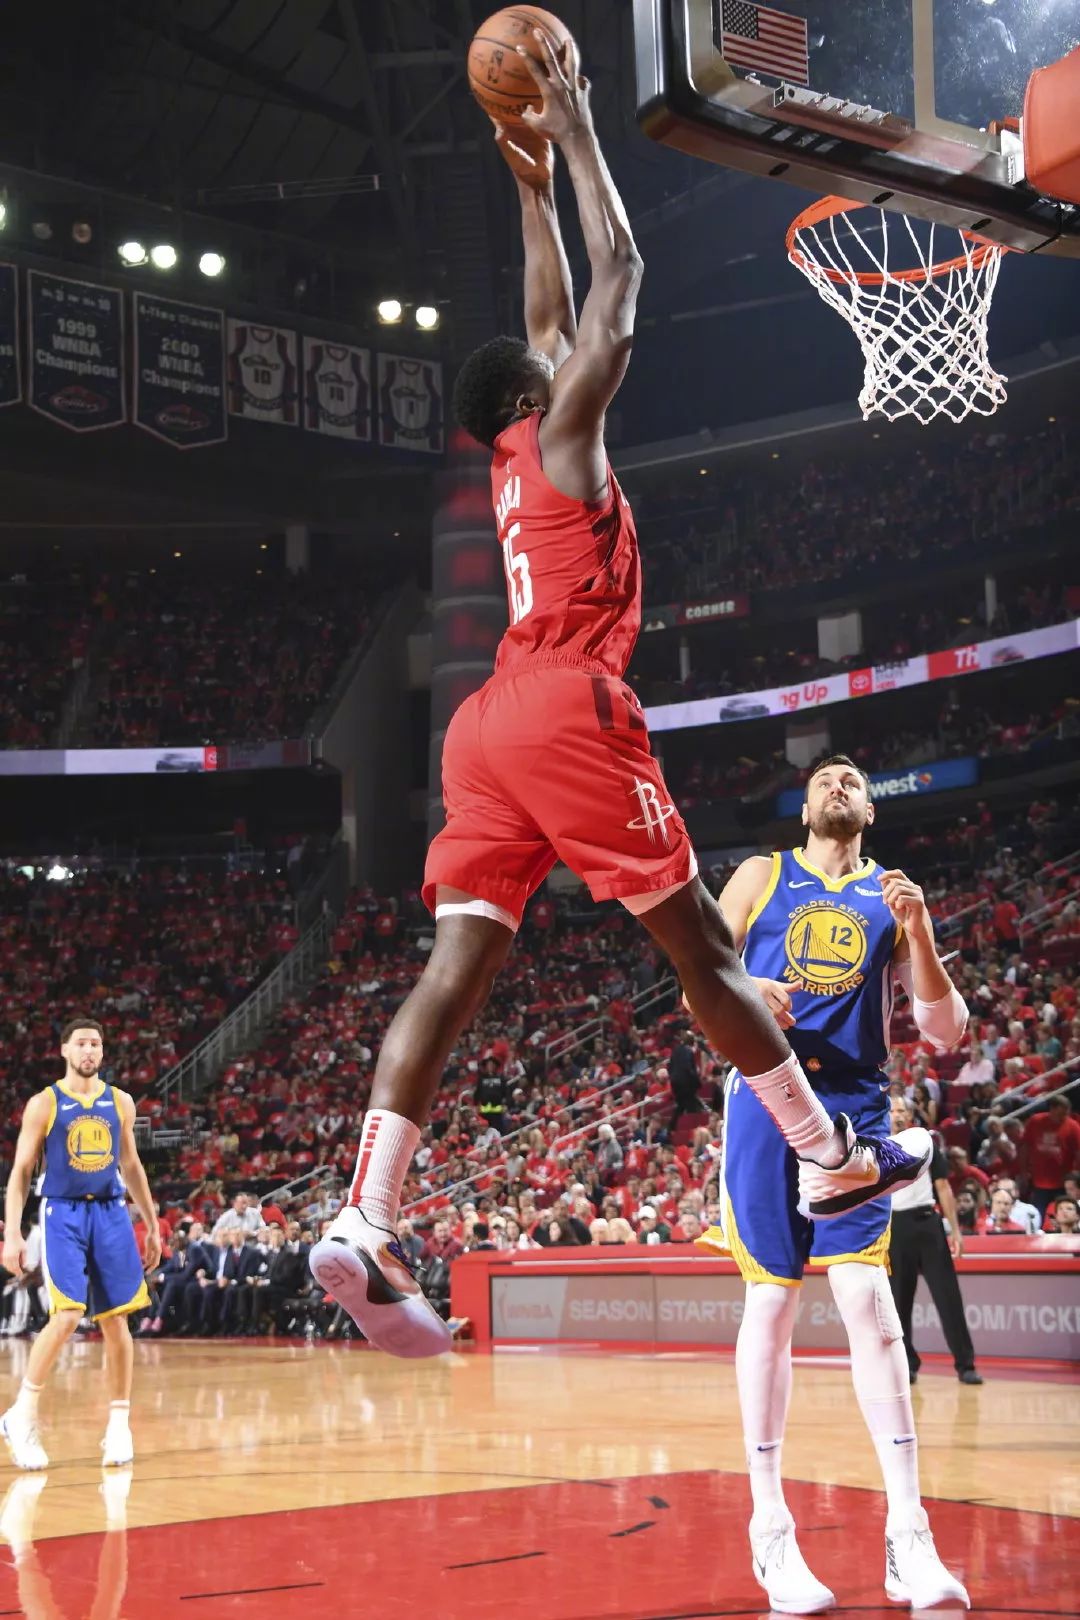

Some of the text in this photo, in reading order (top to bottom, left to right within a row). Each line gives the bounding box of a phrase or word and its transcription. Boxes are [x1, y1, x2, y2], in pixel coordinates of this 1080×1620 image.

[57, 318, 97, 338] 1999
[51, 334, 101, 357] WNBA
[36, 349, 118, 378] Champions
[142, 368, 220, 396] Champions
[804, 684, 827, 704] Up
[788, 900, 869, 928] GOLDEN STATE
[830, 925, 852, 946] 12
[783, 965, 864, 996] WARRIORS
[570, 1299, 652, 1321] SEASON
[659, 1300, 745, 1324] STARTS
